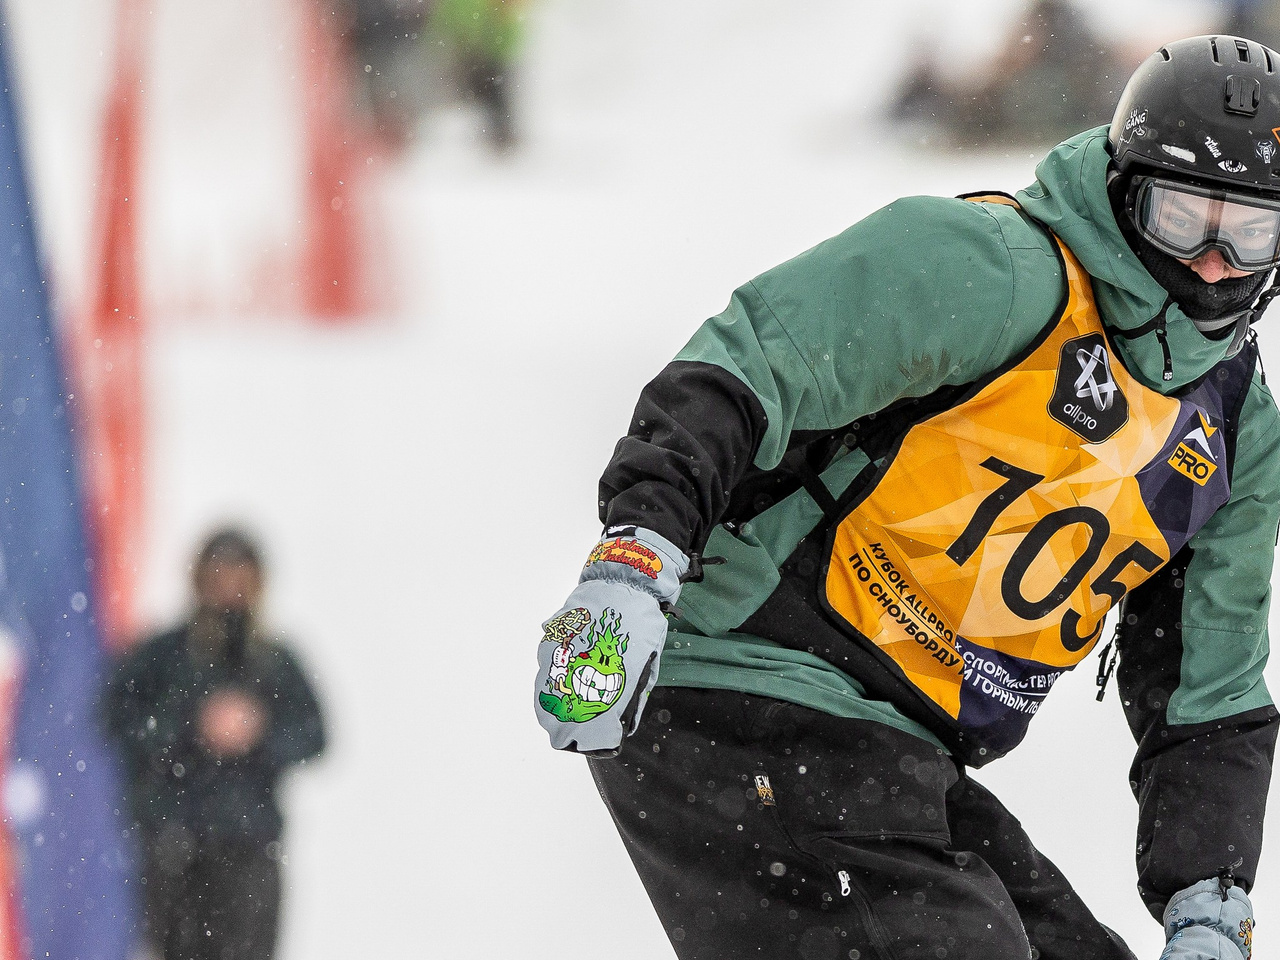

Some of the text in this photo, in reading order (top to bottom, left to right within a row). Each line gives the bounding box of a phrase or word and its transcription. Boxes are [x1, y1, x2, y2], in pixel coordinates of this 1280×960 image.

[1125, 112, 1146, 130] GANG
[1063, 403, 1098, 430] allpro
[1171, 446, 1209, 480] PRO
[602, 549, 658, 580] Industries
[603, 537, 657, 561] Salmon
[945, 455, 1165, 652] 105
[868, 542, 909, 595] КУБОК
[904, 594, 954, 643] ALLPRO
[848, 552, 871, 582] ПО
[868, 582, 961, 667] СНОУБОРДУ
[972, 673, 1030, 713] ГОРНЫМ
